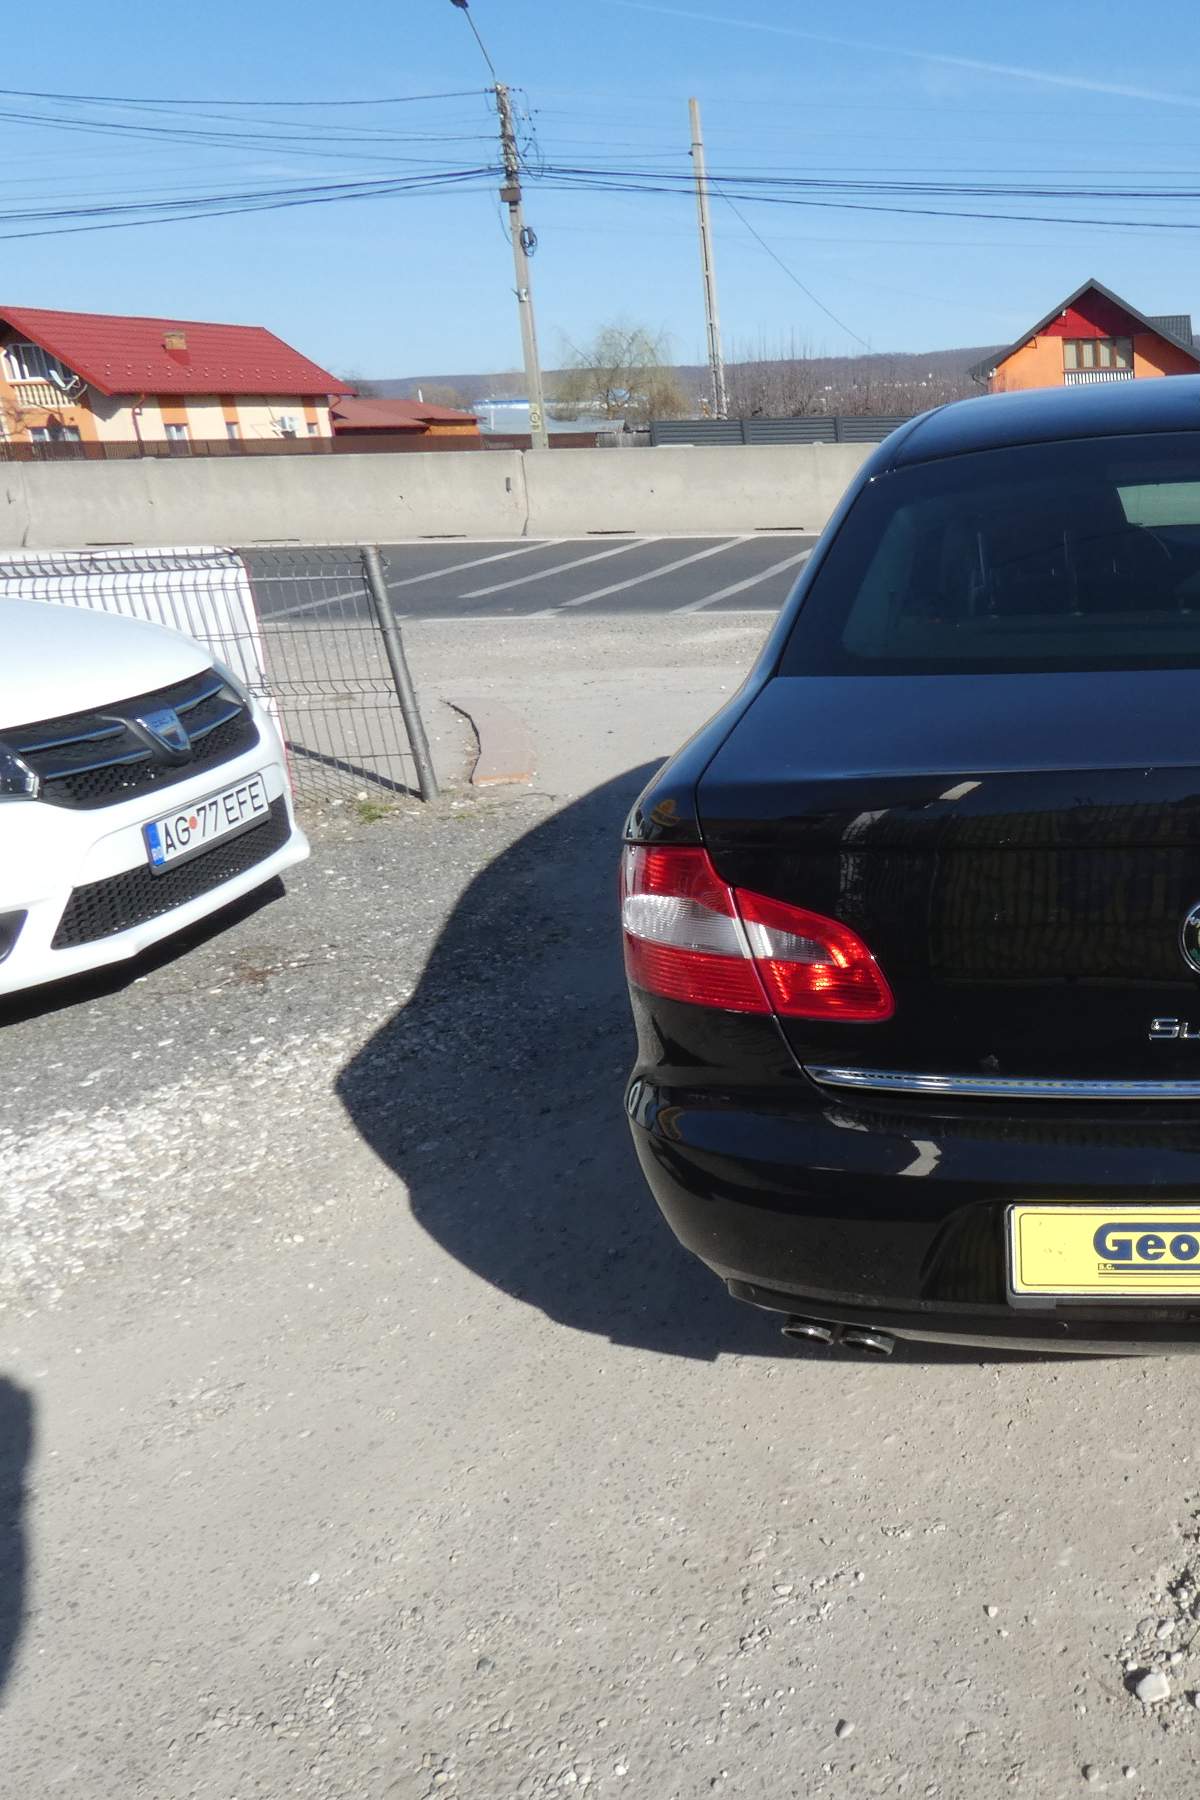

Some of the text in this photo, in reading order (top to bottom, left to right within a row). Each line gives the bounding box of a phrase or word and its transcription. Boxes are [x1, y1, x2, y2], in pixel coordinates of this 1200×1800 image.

[164, 781, 264, 854] AG 77 EFE
